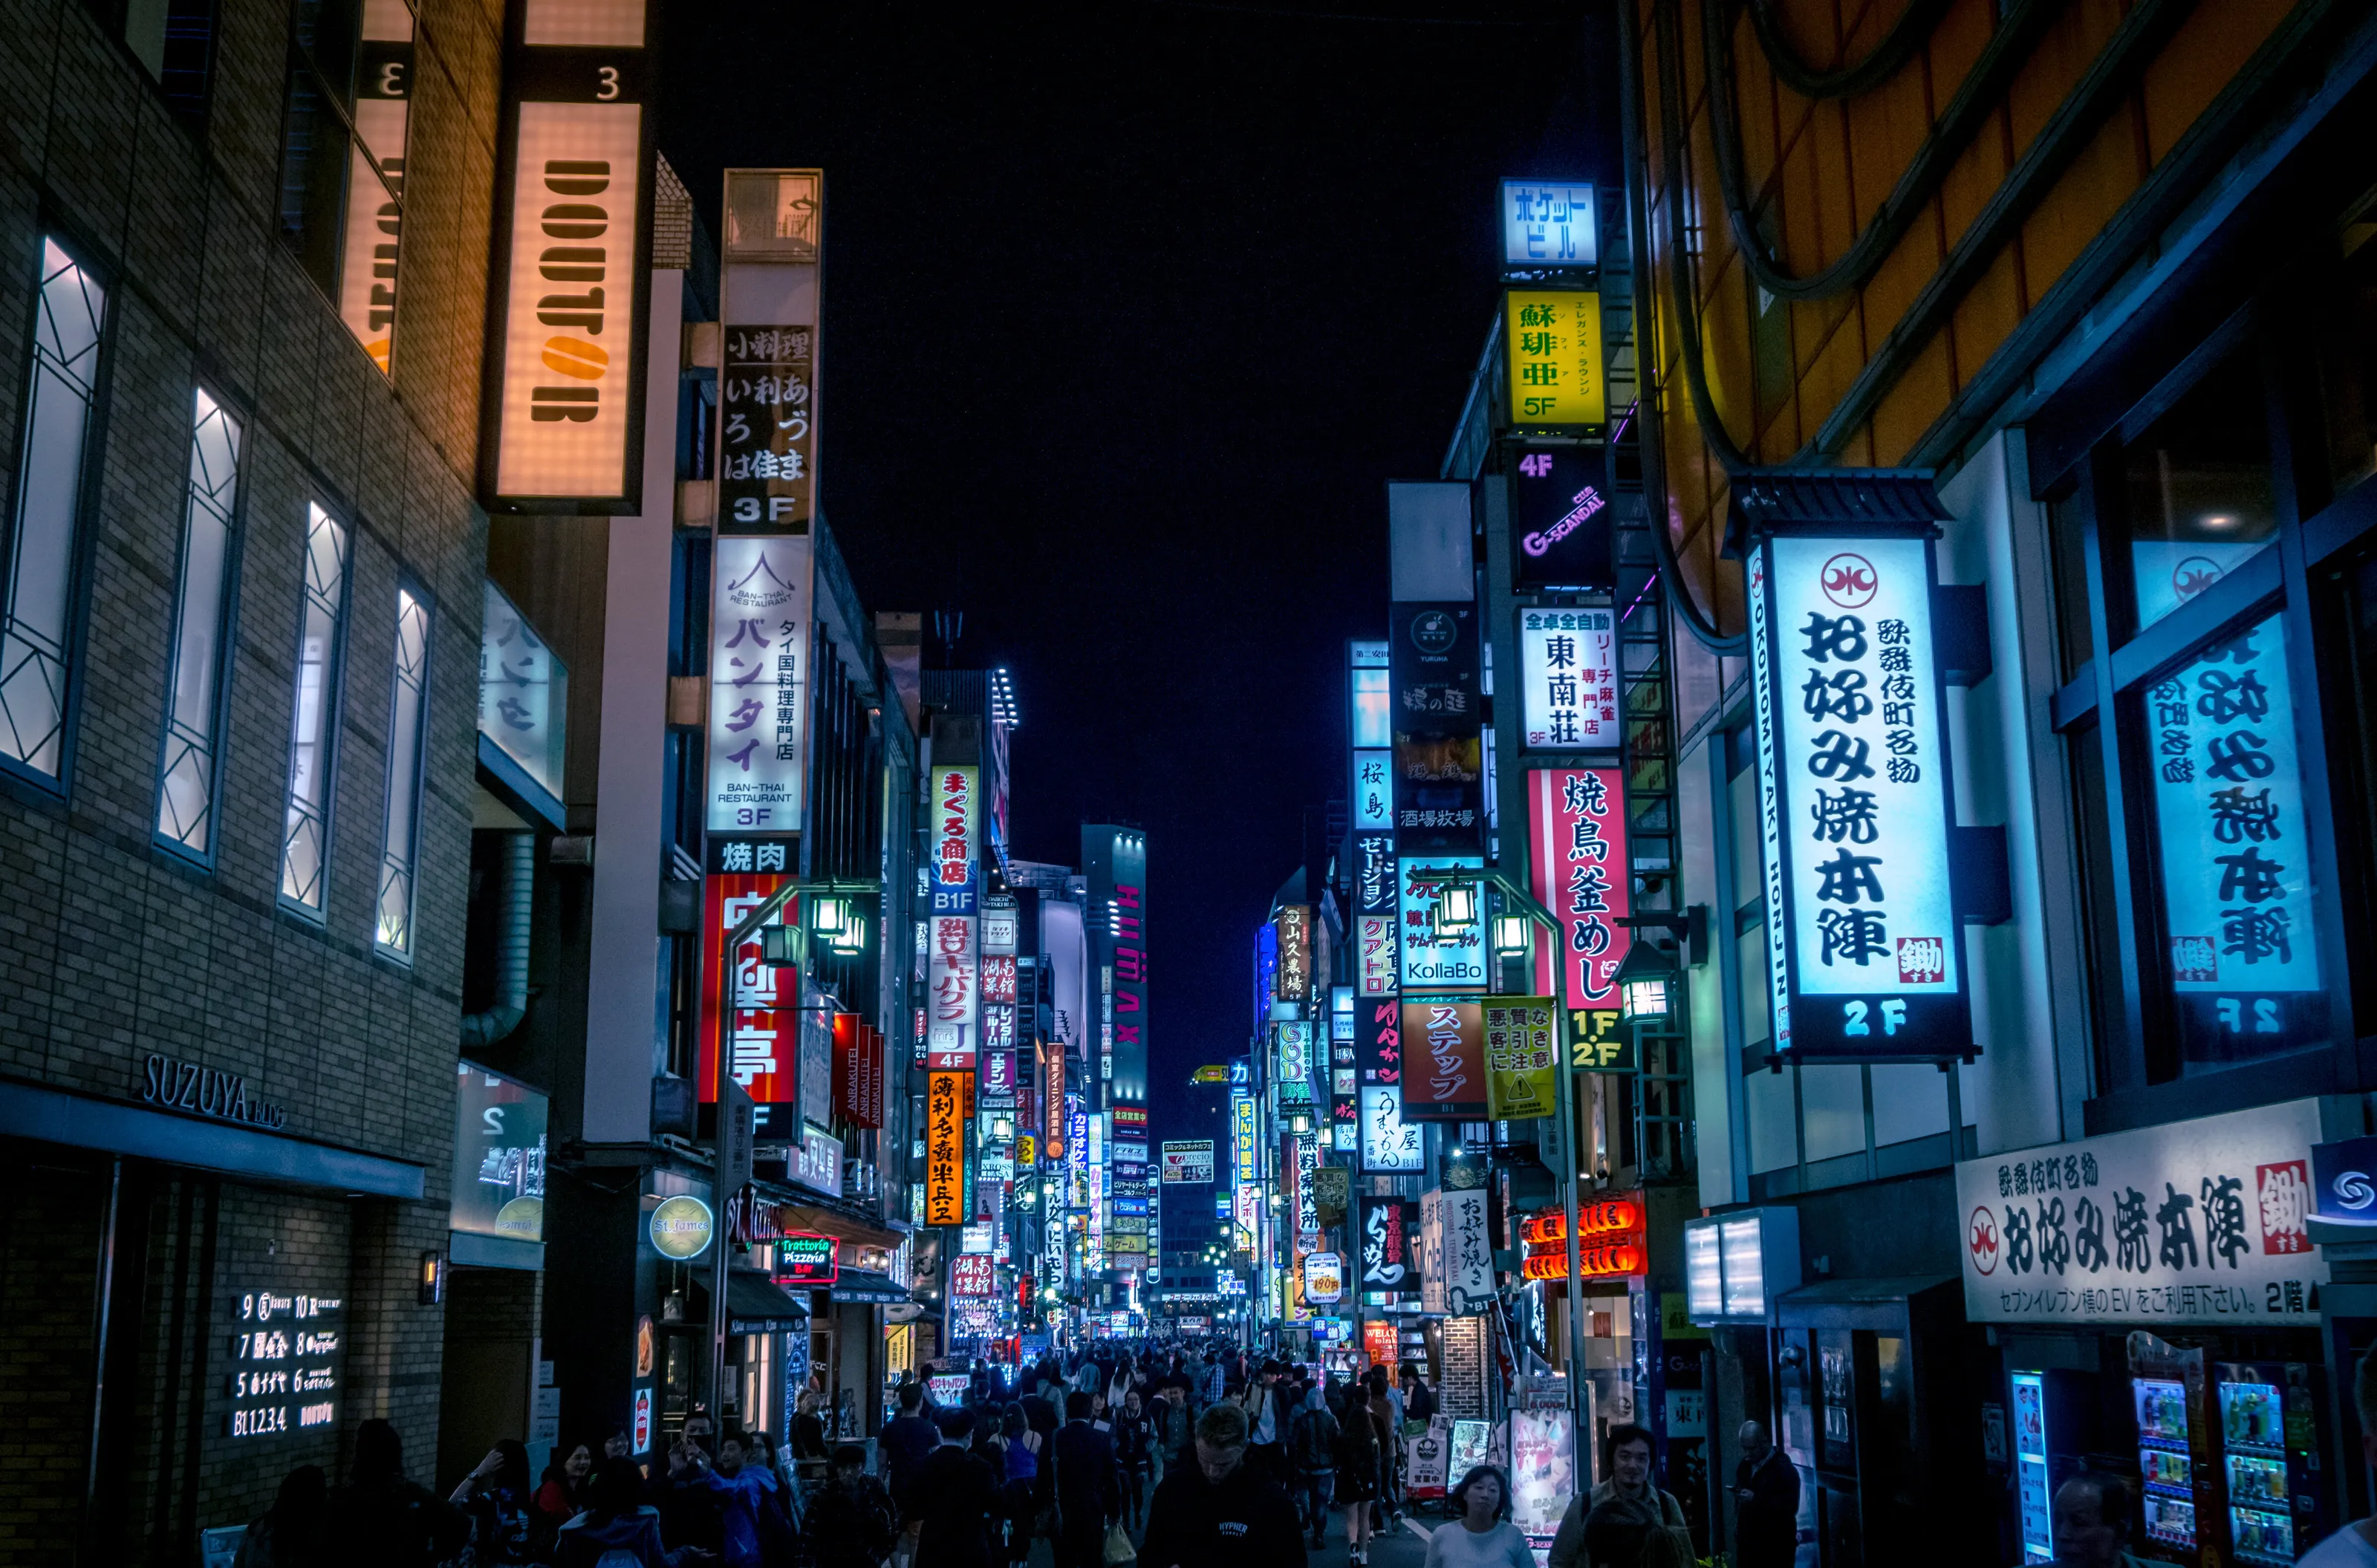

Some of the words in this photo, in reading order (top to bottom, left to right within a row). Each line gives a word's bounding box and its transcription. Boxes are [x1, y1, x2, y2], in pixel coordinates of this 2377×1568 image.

[596, 67, 620, 101] 3
[1515, 188, 1586, 222] ポケット
[1528, 225, 1576, 258] ビル
[530, 160, 611, 423] DOUTOR
[729, 331, 810, 361] 小料理
[1524, 397, 1556, 416] 5F
[723, 377, 752, 481] いろは
[778, 375, 809, 481] あづま
[1519, 454, 1552, 477] 4F
[733, 497, 796, 521] 3F
[1572, 486, 1595, 505] CLUB
[1523, 495, 1605, 557] G-SCANDAL
[729, 594, 792, 608] RESTAURANT
[738, 590, 784, 600] BAN-THAI
[1526, 613, 1610, 631] 全卓全自動
[775, 619, 796, 761] タイ国料理専門店
[1546, 634, 1581, 744] 東南荘
[1597, 634, 1615, 722] リーチ麻雀
[725, 618, 770, 772] バンタイ
[1582, 668, 1599, 735] 専門店
[1876, 618, 1921, 784] 歌舞伎町名物
[1529, 732, 1546, 744] 3F
[718, 794, 792, 803] RESTAURANT
[727, 784, 784, 793] BAN-THAI
[1362, 762, 1385, 819] 桜島
[1754, 602, 1778, 845] OKONOMIYAKI
[1769, 860, 1788, 998] HONJIN
[1798, 611, 1893, 969] お好み焼本陣
[737, 808, 772, 825] 3F
[940, 772, 968, 885] まぐろ商店
[722, 842, 785, 872] 焼肉
[1360, 838, 1382, 908] ゼーション
[934, 893, 973, 909] B1F
[1563, 771, 1613, 1001] 焼鳥釜めし
[984, 958, 1015, 977] 湖南
[1286, 925, 1302, 991] 山久農場
[1365, 919, 1384, 992] クアトロ
[1408, 963, 1482, 978] KollaBo
[986, 1015, 999, 1047] ルーム
[1000, 1006, 1012, 1047] レンタル
[1488, 1008, 1549, 1027] 悪質な
[1573, 1010, 1619, 1035] 1F
[1844, 999, 1907, 1036] 2F
[1281, 1022, 1302, 1080] GOD
[1425, 1006, 1466, 1101] ステップ
[1489, 1030, 1549, 1050] 客引き
[1573, 1042, 1622, 1067] 2F
[940, 1054, 963, 1067] 4F
[991, 1053, 1005, 1084] エデン
[1490, 1051, 1550, 1071] に注意
[143, 1054, 248, 1120] SUZUYA
[254, 1099, 285, 1129] BLDG
[848, 1047, 858, 1110] ANRAKUTEI
[860, 1057, 869, 1119] ANRAKUTEI
[1281, 1082, 1312, 1099] 麻雀
[871, 1067, 880, 1126] ANRAKUTEI
[1074, 1113, 1087, 1161] カラオケ
[1367, 1139, 1377, 1168] 一番街
[1402, 1158, 1422, 1168] B1F
[1299, 1133, 1318, 1230] 無料案内所
[1998, 1151, 2099, 1197] 歌舞伎町名物
[1090, 1168, 1101, 1223] カラオケ
[1241, 1186, 1254, 1227] マンボー
[654, 1219, 673, 1233] St.
[672, 1219, 709, 1234] James
[1386, 1203, 1402, 1263] 東京豚骨
[1446, 1200, 1456, 1237] HIROSHIMA
[2003, 1174, 2251, 1276] お好み焼本陣
[782, 1238, 829, 1252] Trattoria
[784, 1252, 825, 1263] Pizzeria
[1458, 1197, 1489, 1286] お好み焼き
[794, 1263, 814, 1274] Bar
[955, 1256, 992, 1277] 湖南
[1448, 1238, 1460, 1282] TEPPANYAKI
[1314, 1276, 1339, 1289] 190円
[243, 1293, 253, 1319] 9
[296, 1295, 308, 1318] 10
[308, 1298, 319, 1317] R
[240, 1333, 250, 1359] 7
[297, 1331, 306, 1356] 8
[237, 1372, 247, 1397] 5
[293, 1368, 304, 1393] 6
[1414, 1474, 1440, 1483] 営業中
